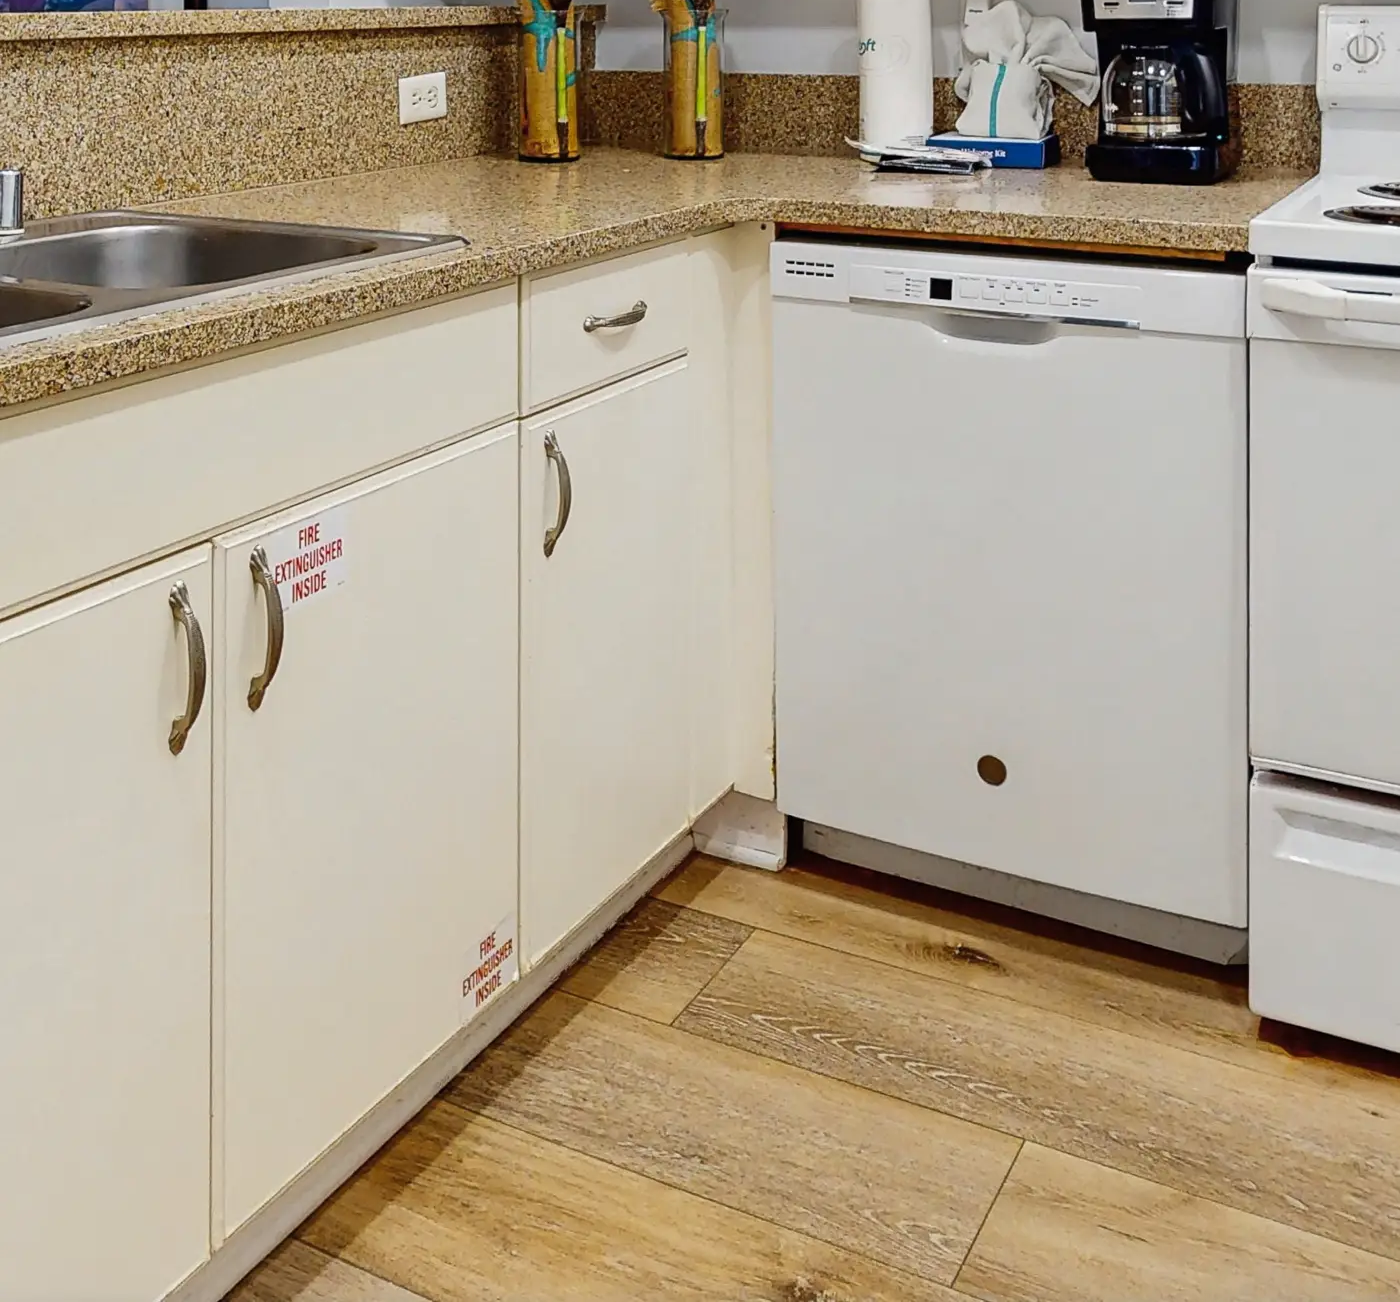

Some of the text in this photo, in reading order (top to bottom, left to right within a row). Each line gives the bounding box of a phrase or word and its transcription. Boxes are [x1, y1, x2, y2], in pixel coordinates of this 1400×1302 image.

[994, 149, 1006, 157] Kit
[298, 523, 320, 549] FIRE
[274, 539, 343, 585] EXTINGUISHER
[292, 570, 327, 603] INSIDE
[479, 931, 496, 959] FIRE
[462, 938, 513, 998] EXTINGUISHER
[475, 970, 502, 1007] INSIDE
